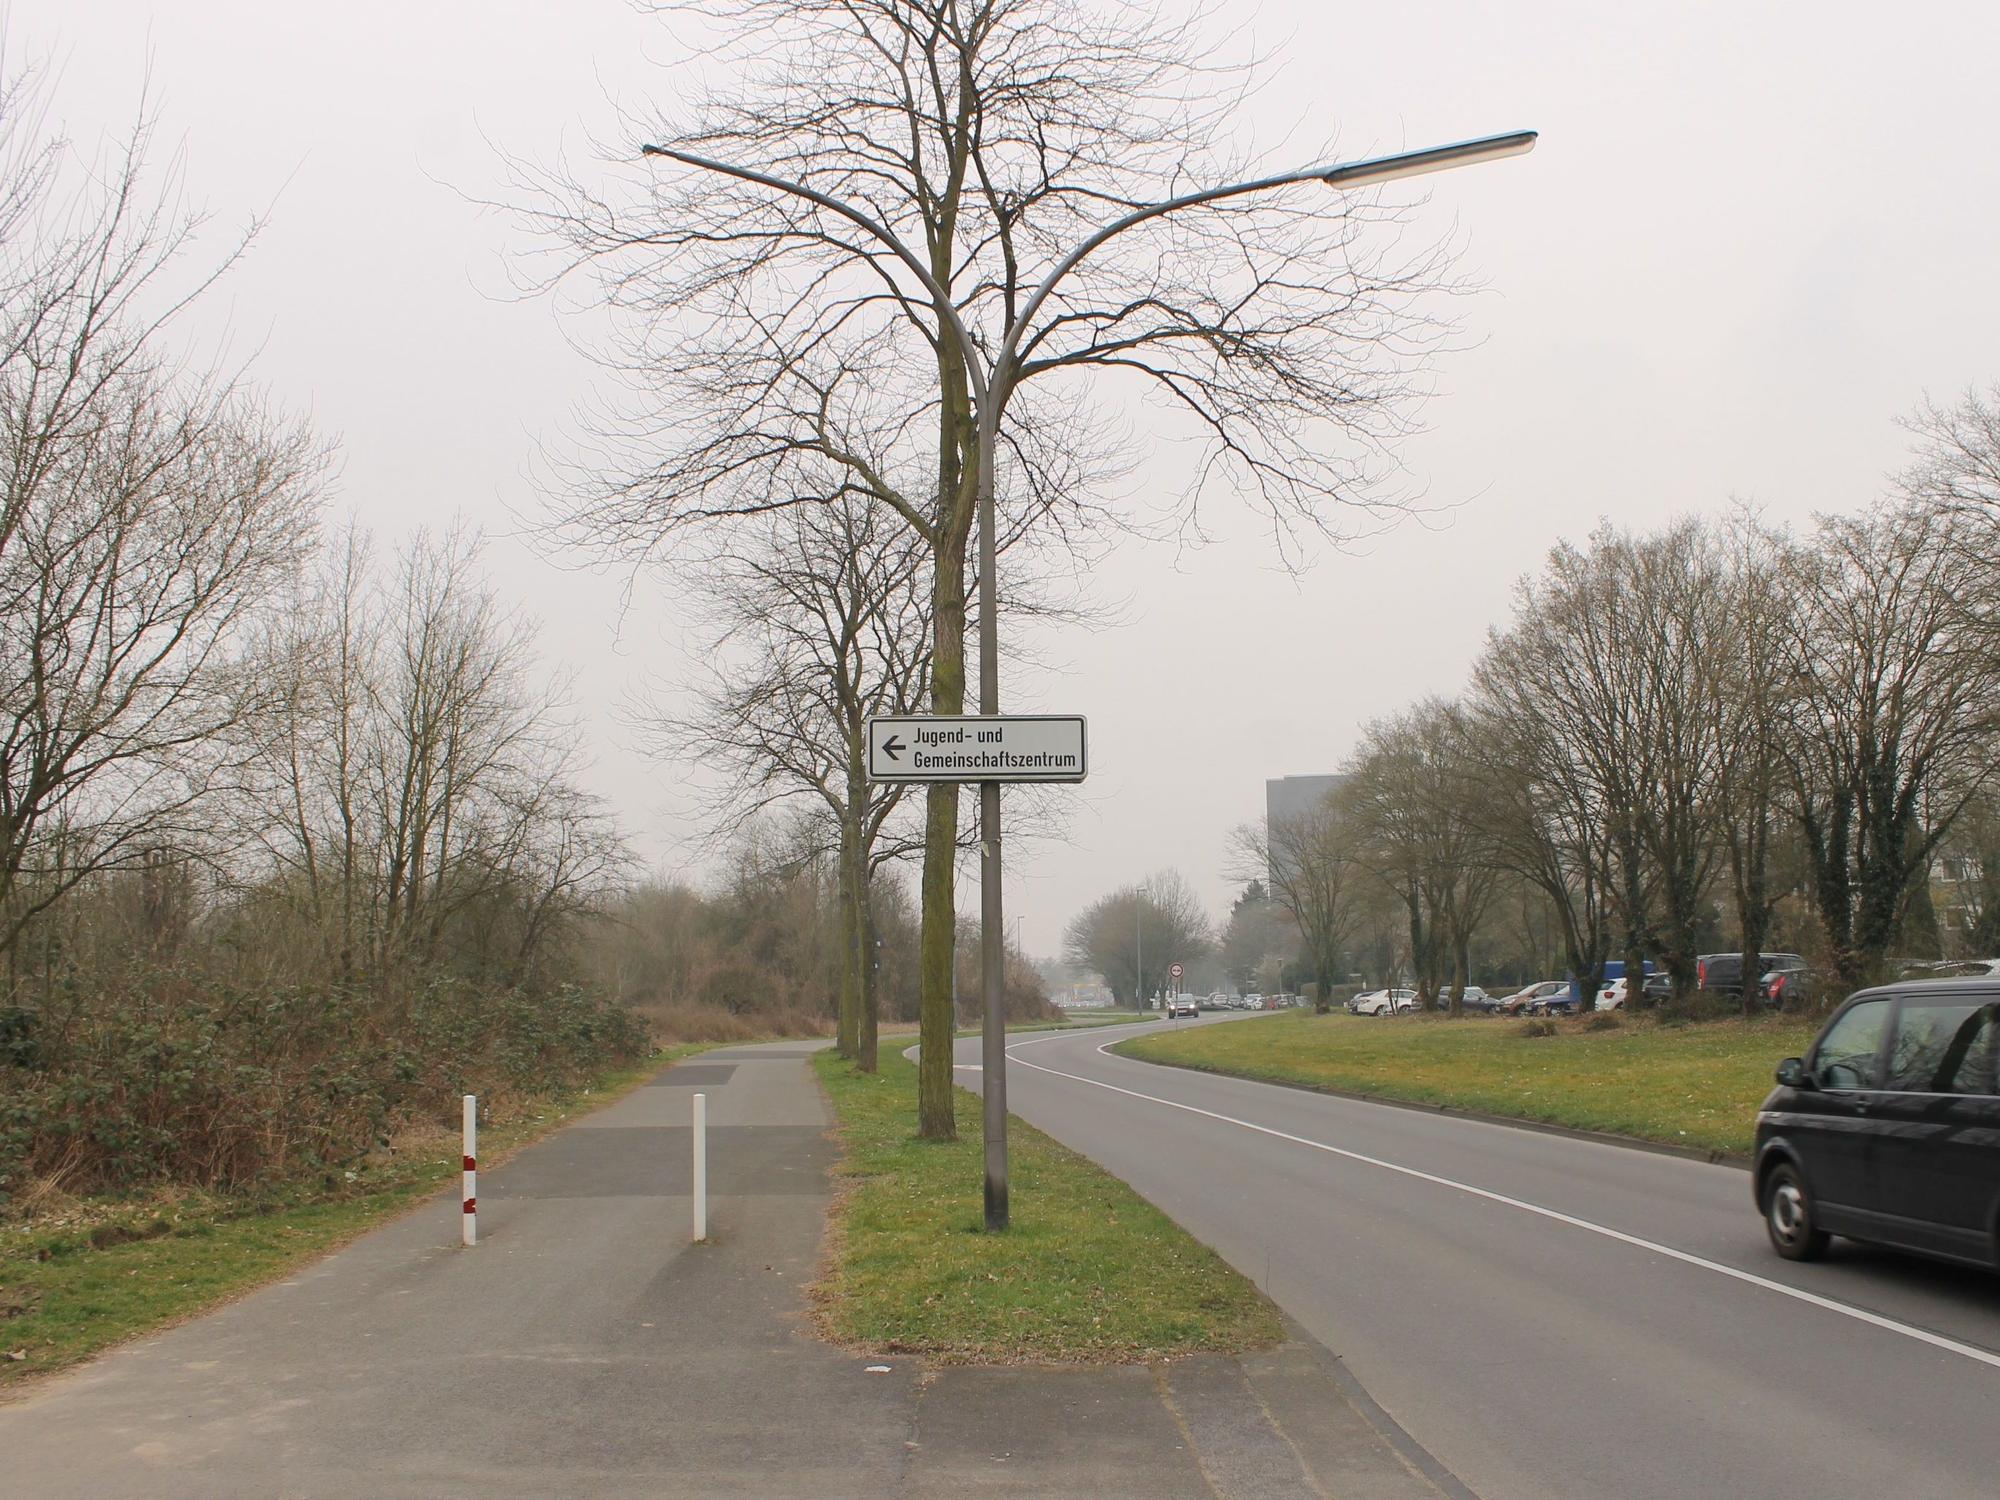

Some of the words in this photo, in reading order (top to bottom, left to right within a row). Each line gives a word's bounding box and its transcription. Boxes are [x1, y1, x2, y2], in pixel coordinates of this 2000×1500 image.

[914, 727, 972, 747] Jugend-
[977, 727, 1003, 743] und
[914, 751, 1076, 768] Gemeinschaftszentrum
